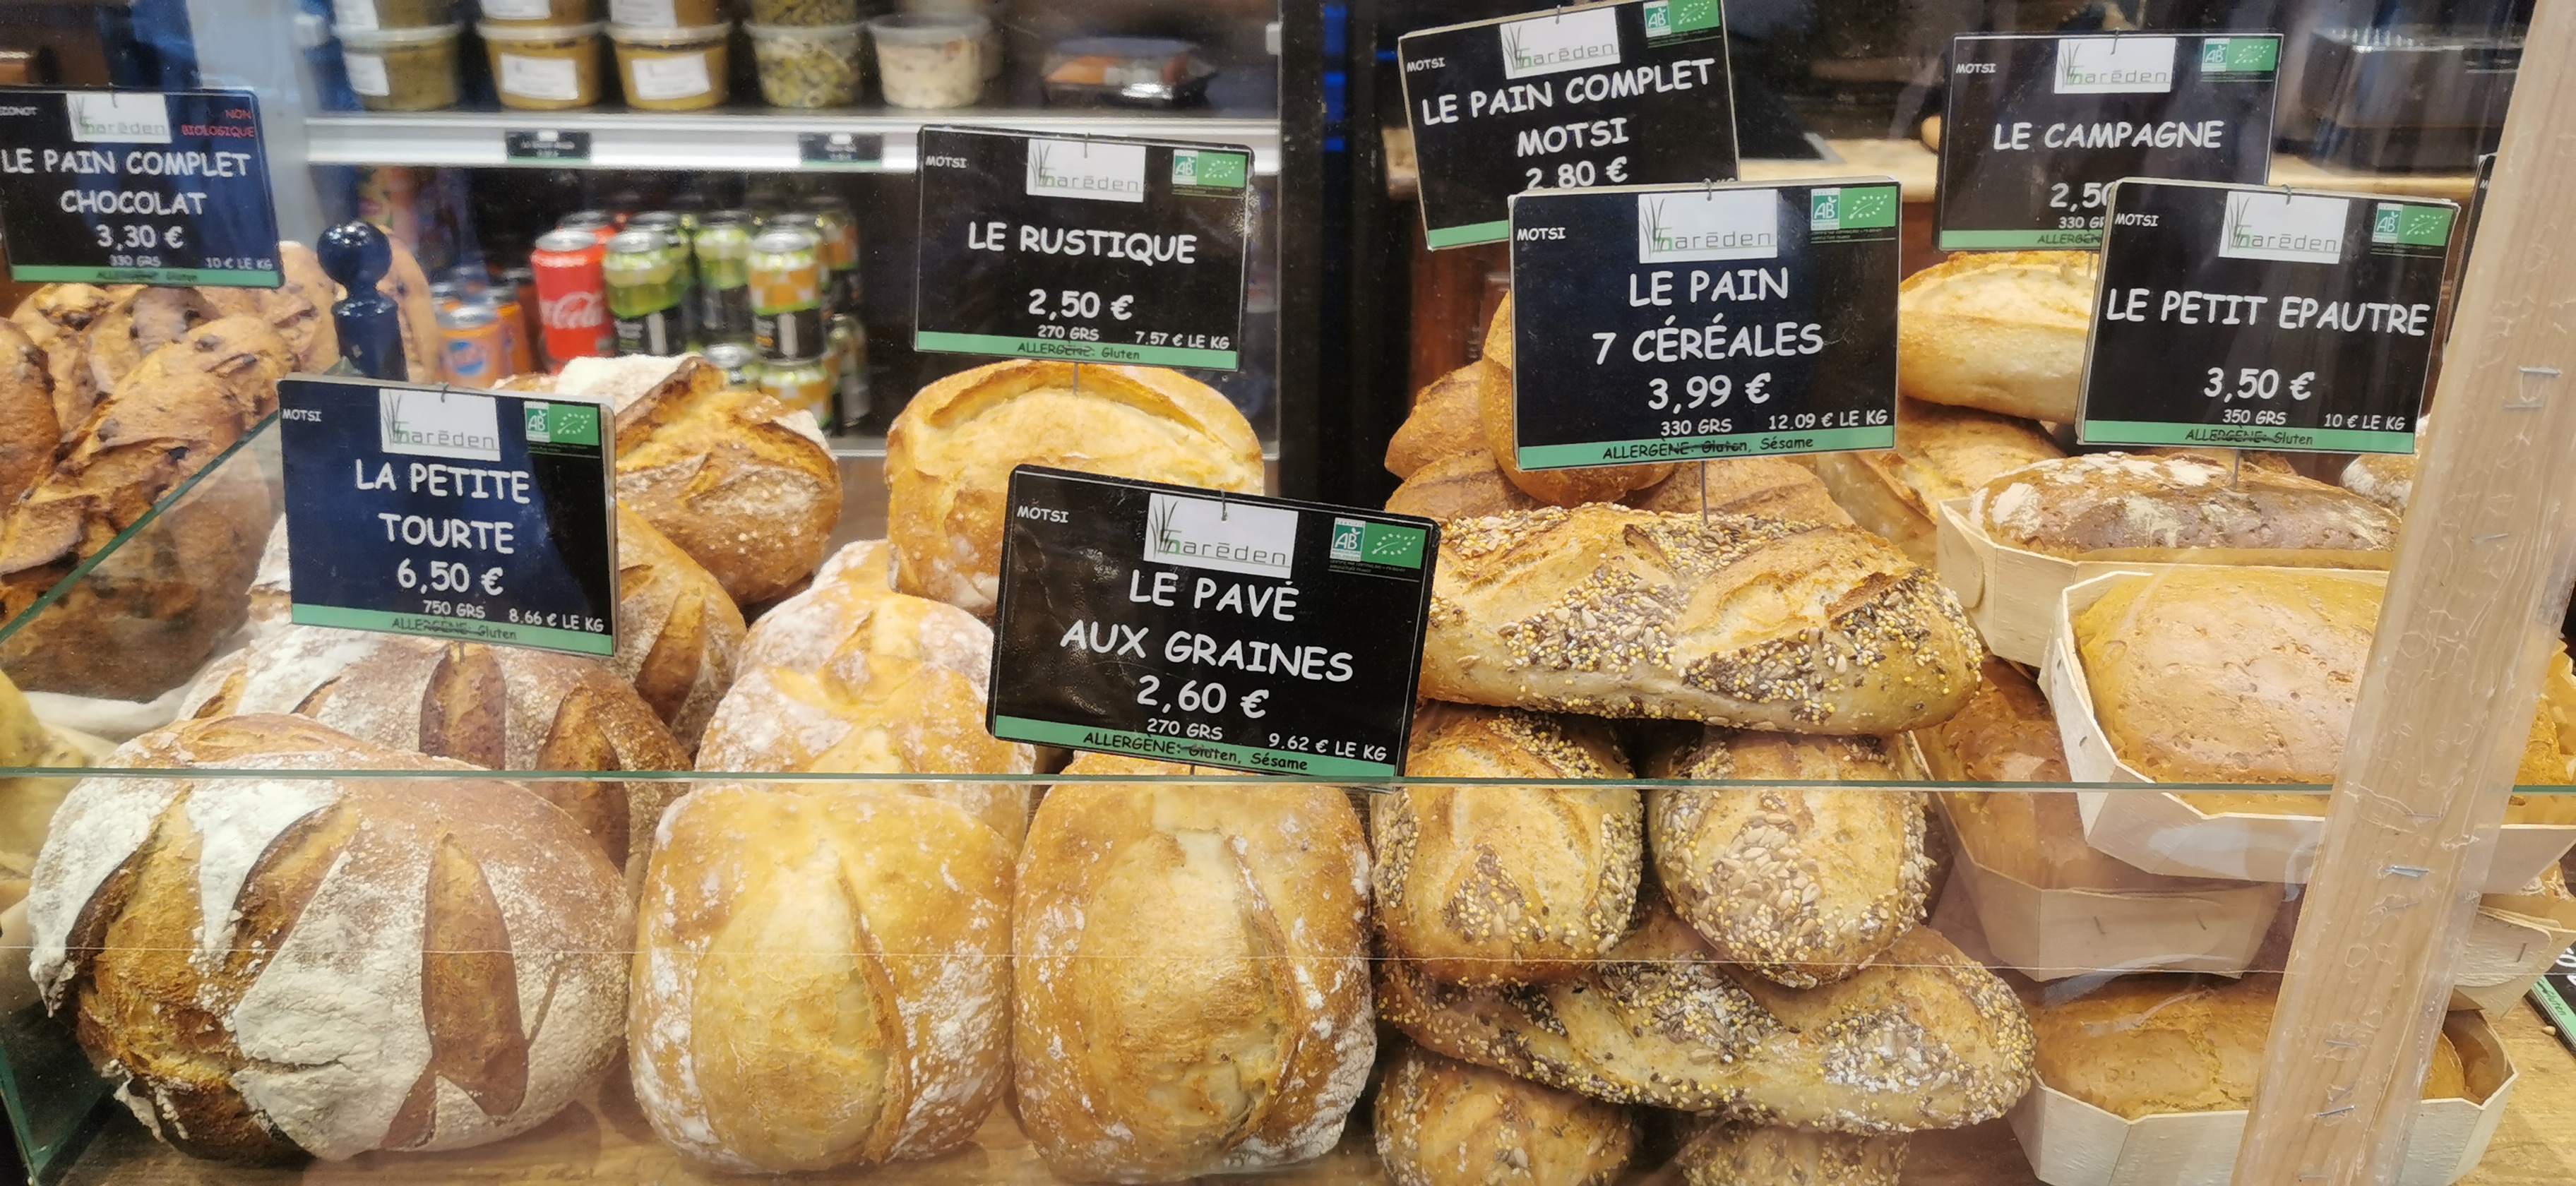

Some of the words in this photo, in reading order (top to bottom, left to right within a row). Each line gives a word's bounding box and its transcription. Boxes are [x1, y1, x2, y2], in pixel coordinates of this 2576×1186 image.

[1648, 13, 1665, 28] AB
[1407, 57, 1445, 73] MOTSI
[2205, 49, 2224, 64] AB
[1955, 63, 1996, 74] MOTSI
[1422, 95, 1459, 126] LE
[1471, 81, 1553, 119] PAIN
[1565, 58, 1716, 104] COMPLET
[1517, 118, 1630, 157] MOTSI
[1993, 123, 2032, 150] LE
[2044, 121, 2225, 149] CAMPAGNE
[1, 149, 34, 174] LE
[44, 150, 117, 174] PAIN
[126, 152, 252, 178] COMPLET
[926, 155, 967, 169] MOTSI
[1175, 161, 1195, 176] AB
[1525, 160, 1595, 189] 280
[1606, 156, 1628, 183] €
[59, 191, 207, 215] CHOCOLAT
[1814, 202, 1835, 219] AB
[2058, 216, 2085, 229] 330
[2115, 213, 2159, 228] MOTSI
[2377, 215, 2396, 233] AB
[96, 224, 157, 251] 3,30
[164, 226, 184, 248] €
[1517, 227, 1566, 241] MOTSI
[968, 222, 1007, 251] LE
[1020, 226, 1198, 266] RUSTIQUE
[237, 257, 253, 270] LE
[256, 258, 274, 270] KG
[1628, 270, 1674, 307] LE
[1690, 268, 1789, 304] PAIN
[1029, 289, 1101, 321] 2,50
[1111, 294, 1134, 321] €
[2106, 288, 2149, 322] LE
[2161, 291, 2267, 326] PETIT
[2279, 296, 2431, 337] EPAUTRE
[1037, 325, 1064, 339] 270
[1069, 327, 1099, 342] GRS
[1135, 330, 1168, 345] 7.57
[1172, 334, 1183, 347] €
[1188, 336, 1205, 349] LE
[1210, 336, 1230, 349] KG
[1592, 332, 1617, 366] 7
[1632, 313, 1824, 363] CÉRÉALES
[1102, 347, 1140, 360] Gluten
[1648, 375, 1731, 414] 3,99
[1745, 373, 1772, 405] €
[2204, 367, 2280, 403] 3,50
[2289, 371, 2315, 400] €
[282, 409, 321, 422] MOTSI
[528, 412, 547, 431] AB
[1768, 414, 1816, 431] 12.09
[1821, 414, 1833, 427] €
[1839, 412, 1859, 426] LE
[1866, 409, 1888, 424] KG
[2222, 409, 2250, 424] 350
[2255, 411, 2286, 425] GRS
[2325, 414, 2342, 427] 10
[2347, 416, 2359, 428] €
[2362, 415, 2380, 429] LE
[2385, 416, 2405, 431] KG
[1660, 421, 1692, 436] 330
[1697, 419, 1732, 434] GRS
[1760, 437, 1813, 450] Sésame
[356, 459, 395, 491] LA
[410, 463, 530, 504] PETITE
[1017, 506, 1068, 523] MOTSI
[378, 513, 514, 554] TOURTE
[1334, 532, 1358, 550] AB
[398, 558, 470, 594] 6,50
[481, 567, 503, 595] €
[1130, 570, 1179, 607] LE
[1193, 578, 1299, 622] PAVÉ
[423, 600, 451, 615] 750
[456, 604, 486, 619] GRS
[508, 609, 543, 625] 8.66
[547, 613, 557, 627] €
[562, 614, 580, 630] LE
[585, 617, 604, 633] KG
[1061, 620, 1150, 659] AUX
[1164, 630, 1354, 682] GRAINES
[1137, 676, 1227, 714] 2,60
[1241, 688, 1269, 719] €
[1147, 718, 1179, 735] 270
[1186, 724, 1222, 740] GRS
[1268, 733, 1309, 751] 9.62
[1316, 739, 1328, 753] €
[1335, 741, 1356, 757] LE
[1363, 745, 1387, 762] KG
[1251, 752, 1308, 770] Sésame
